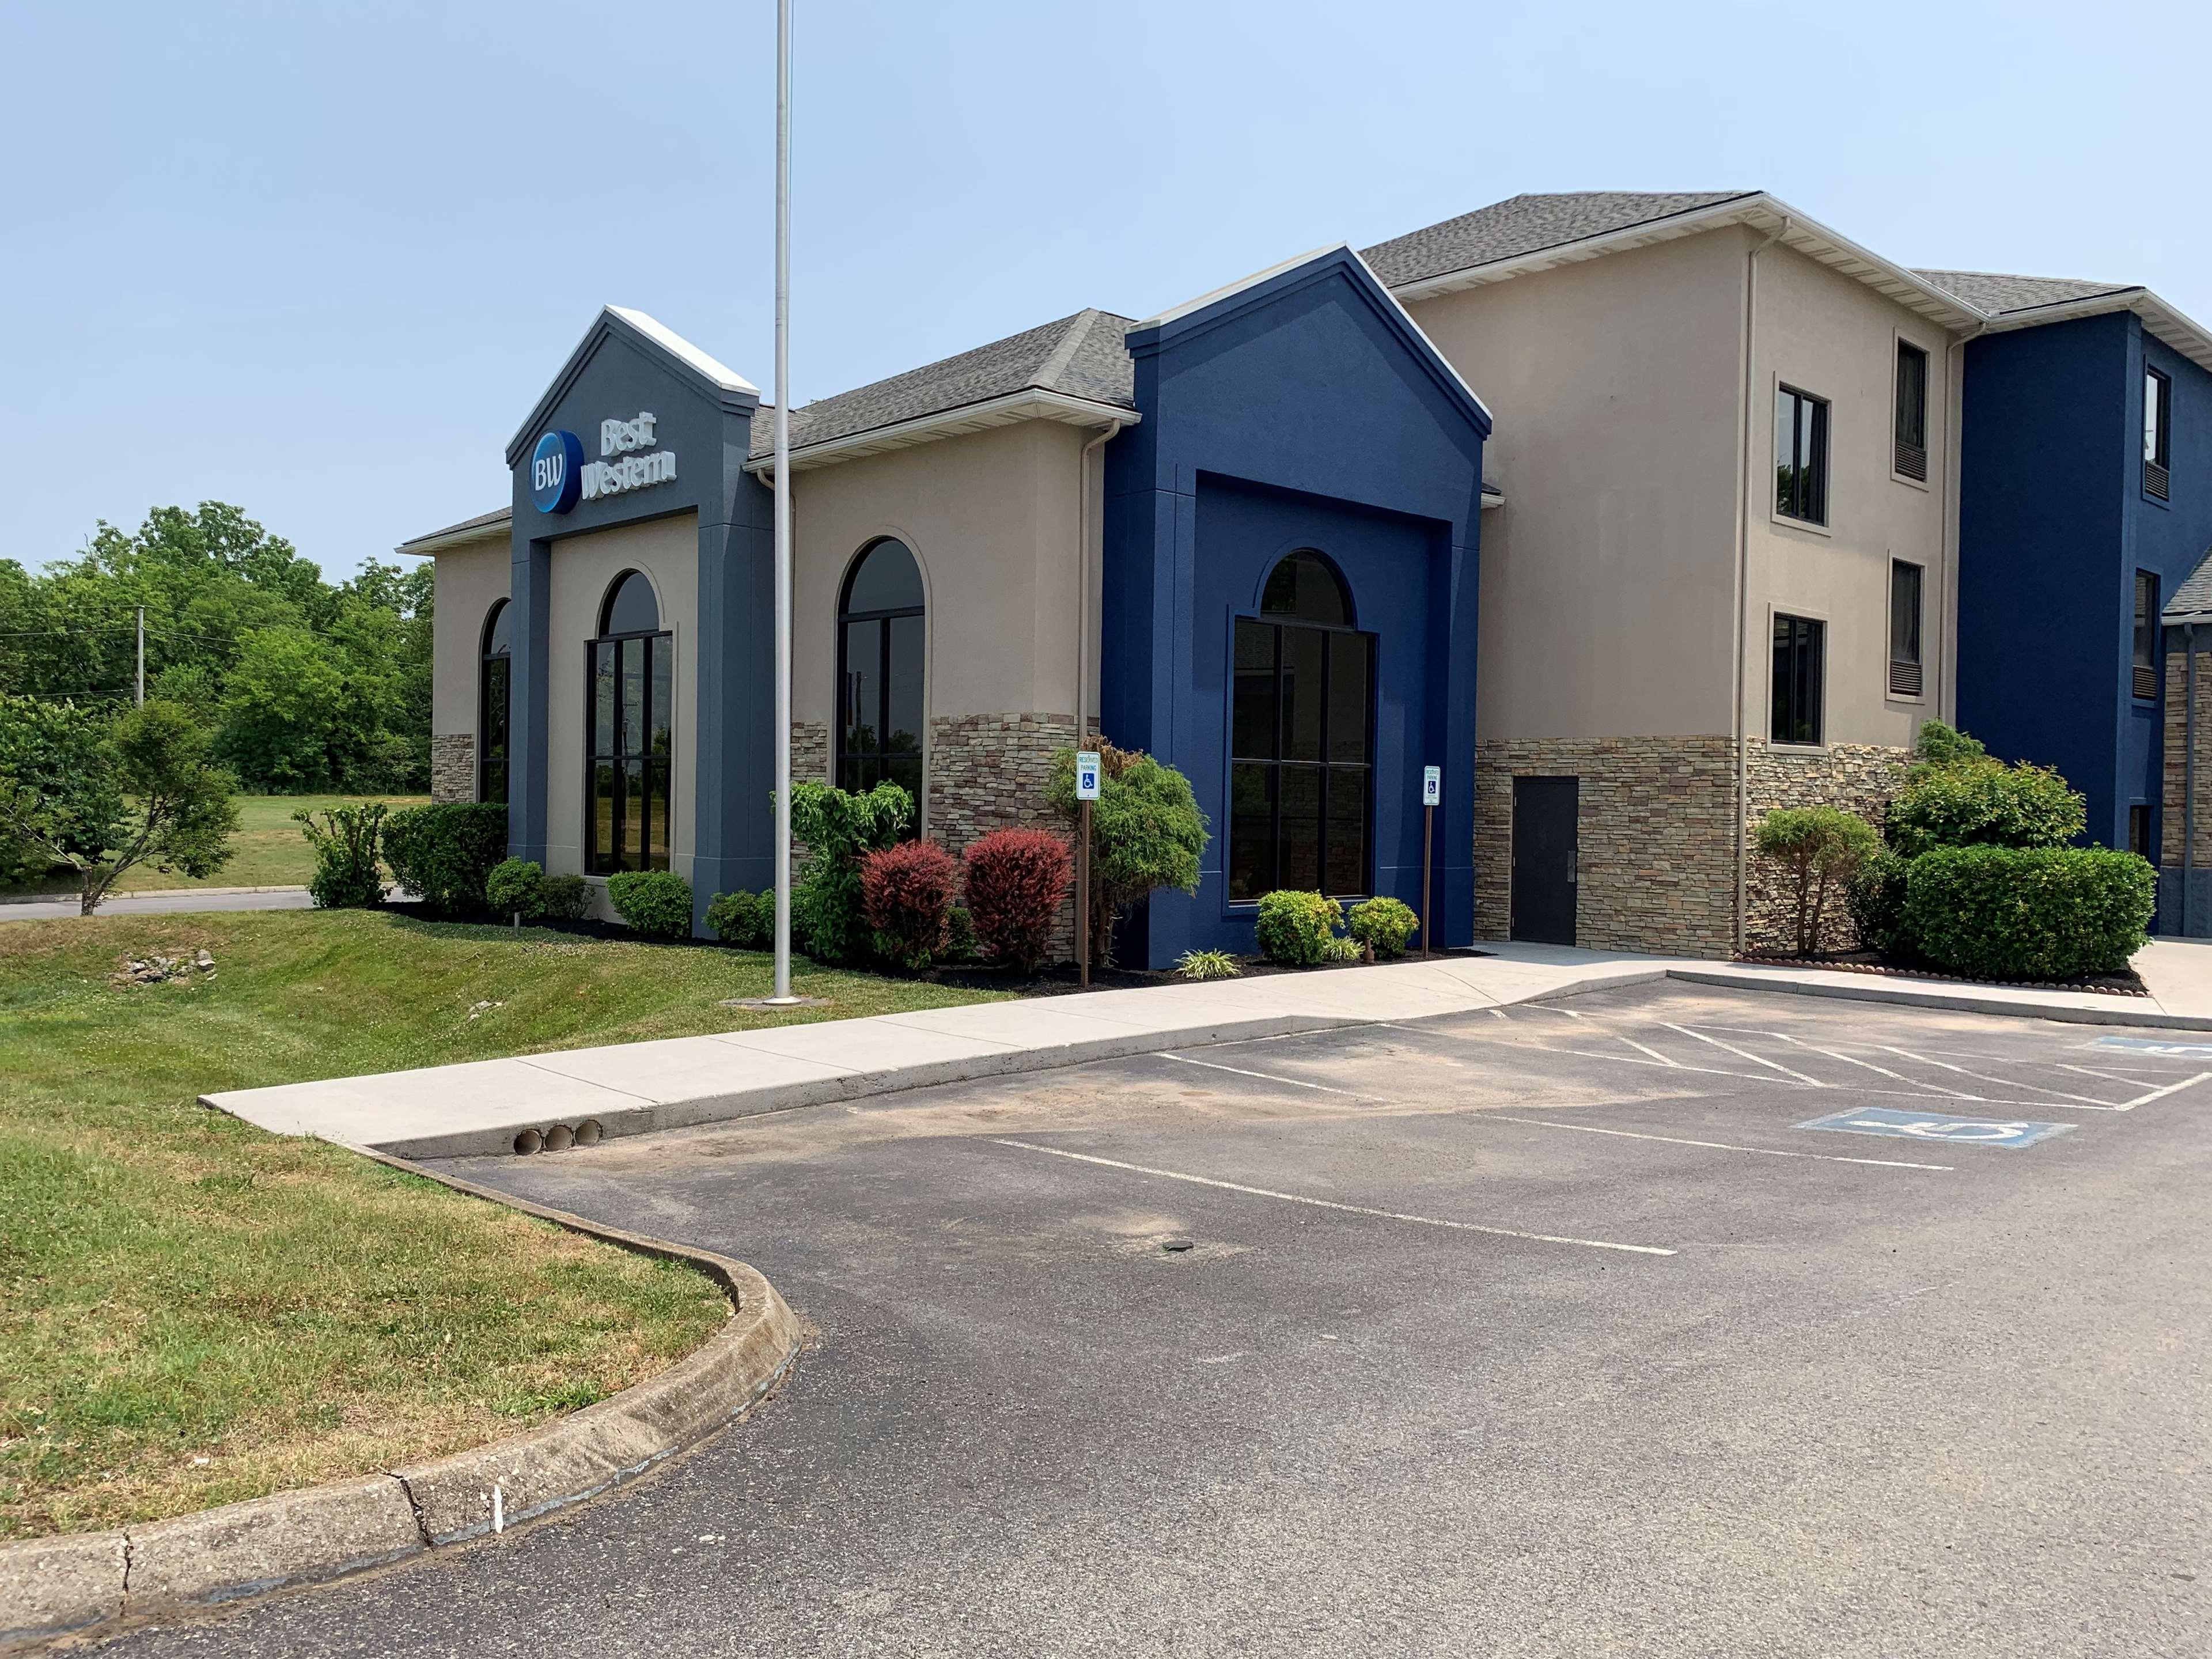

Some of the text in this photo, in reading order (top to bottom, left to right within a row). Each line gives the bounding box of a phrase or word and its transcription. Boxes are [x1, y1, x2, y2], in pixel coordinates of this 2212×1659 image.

[601, 411, 657, 456] Best
[535, 453, 563, 491] BW
[581, 450, 677, 500] Western
